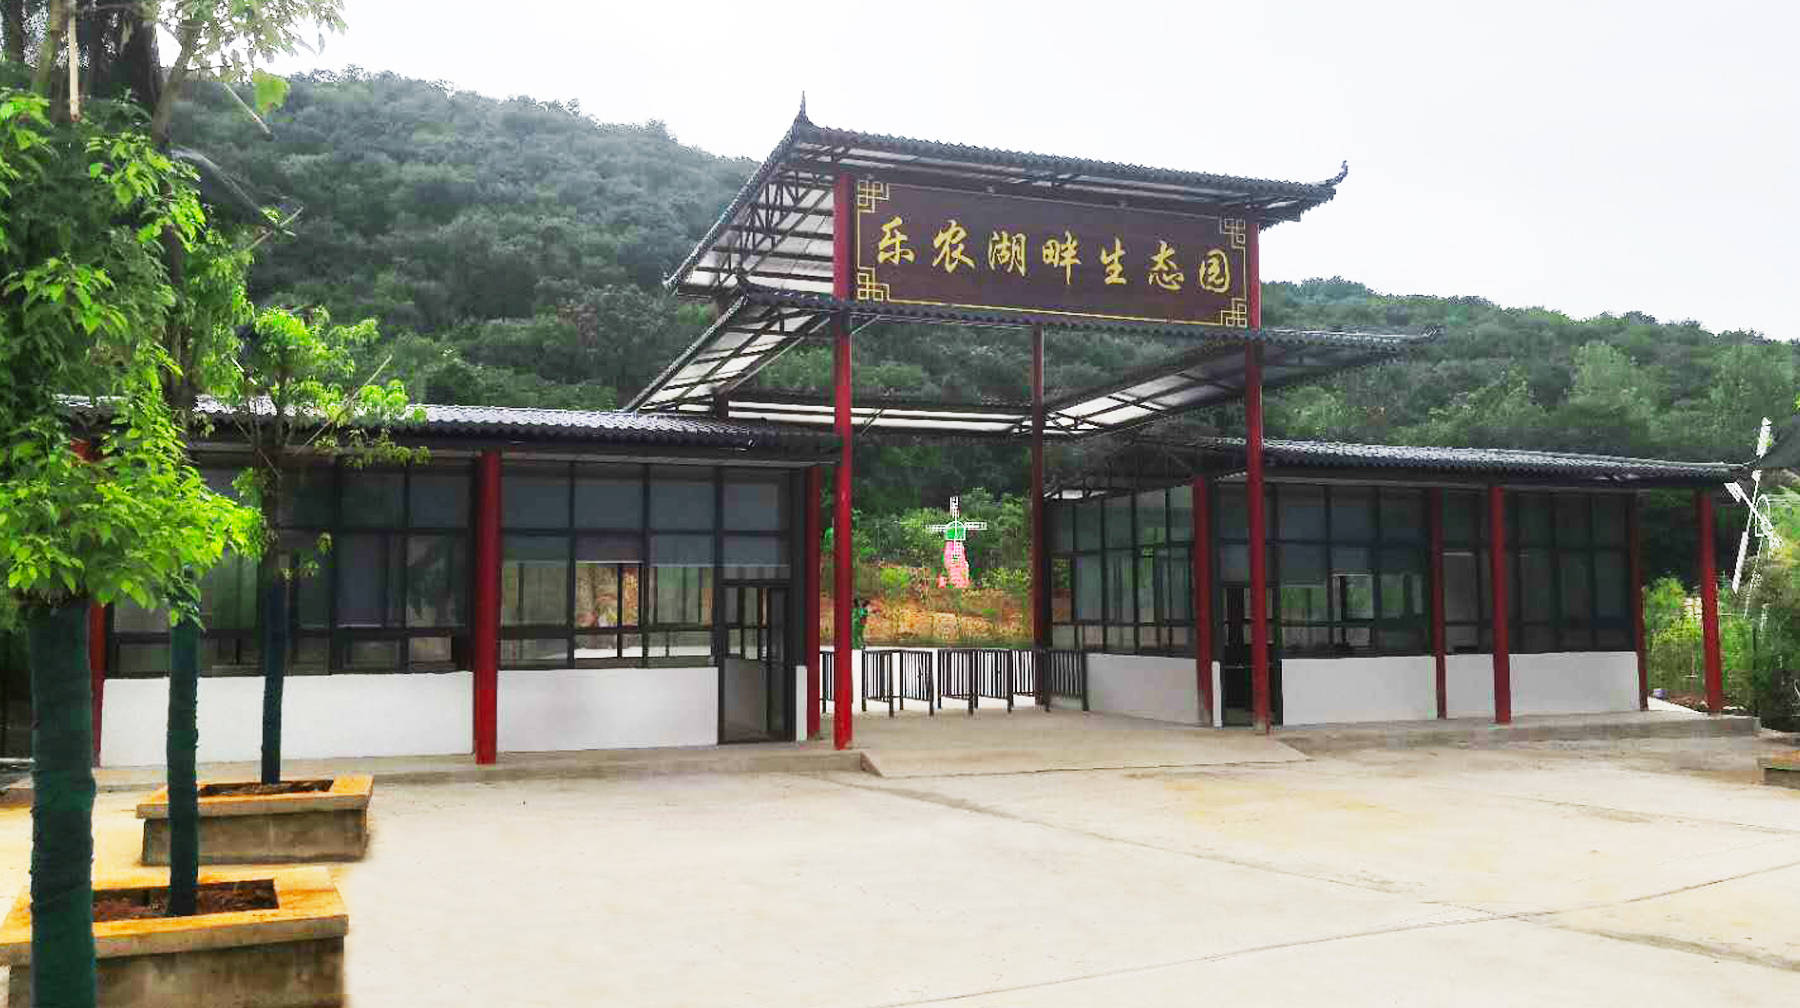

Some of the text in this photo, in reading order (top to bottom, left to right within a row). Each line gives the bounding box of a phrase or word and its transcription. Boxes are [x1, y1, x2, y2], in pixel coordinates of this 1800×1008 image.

[876, 216, 1230, 294] 乐农湖畔生态园
